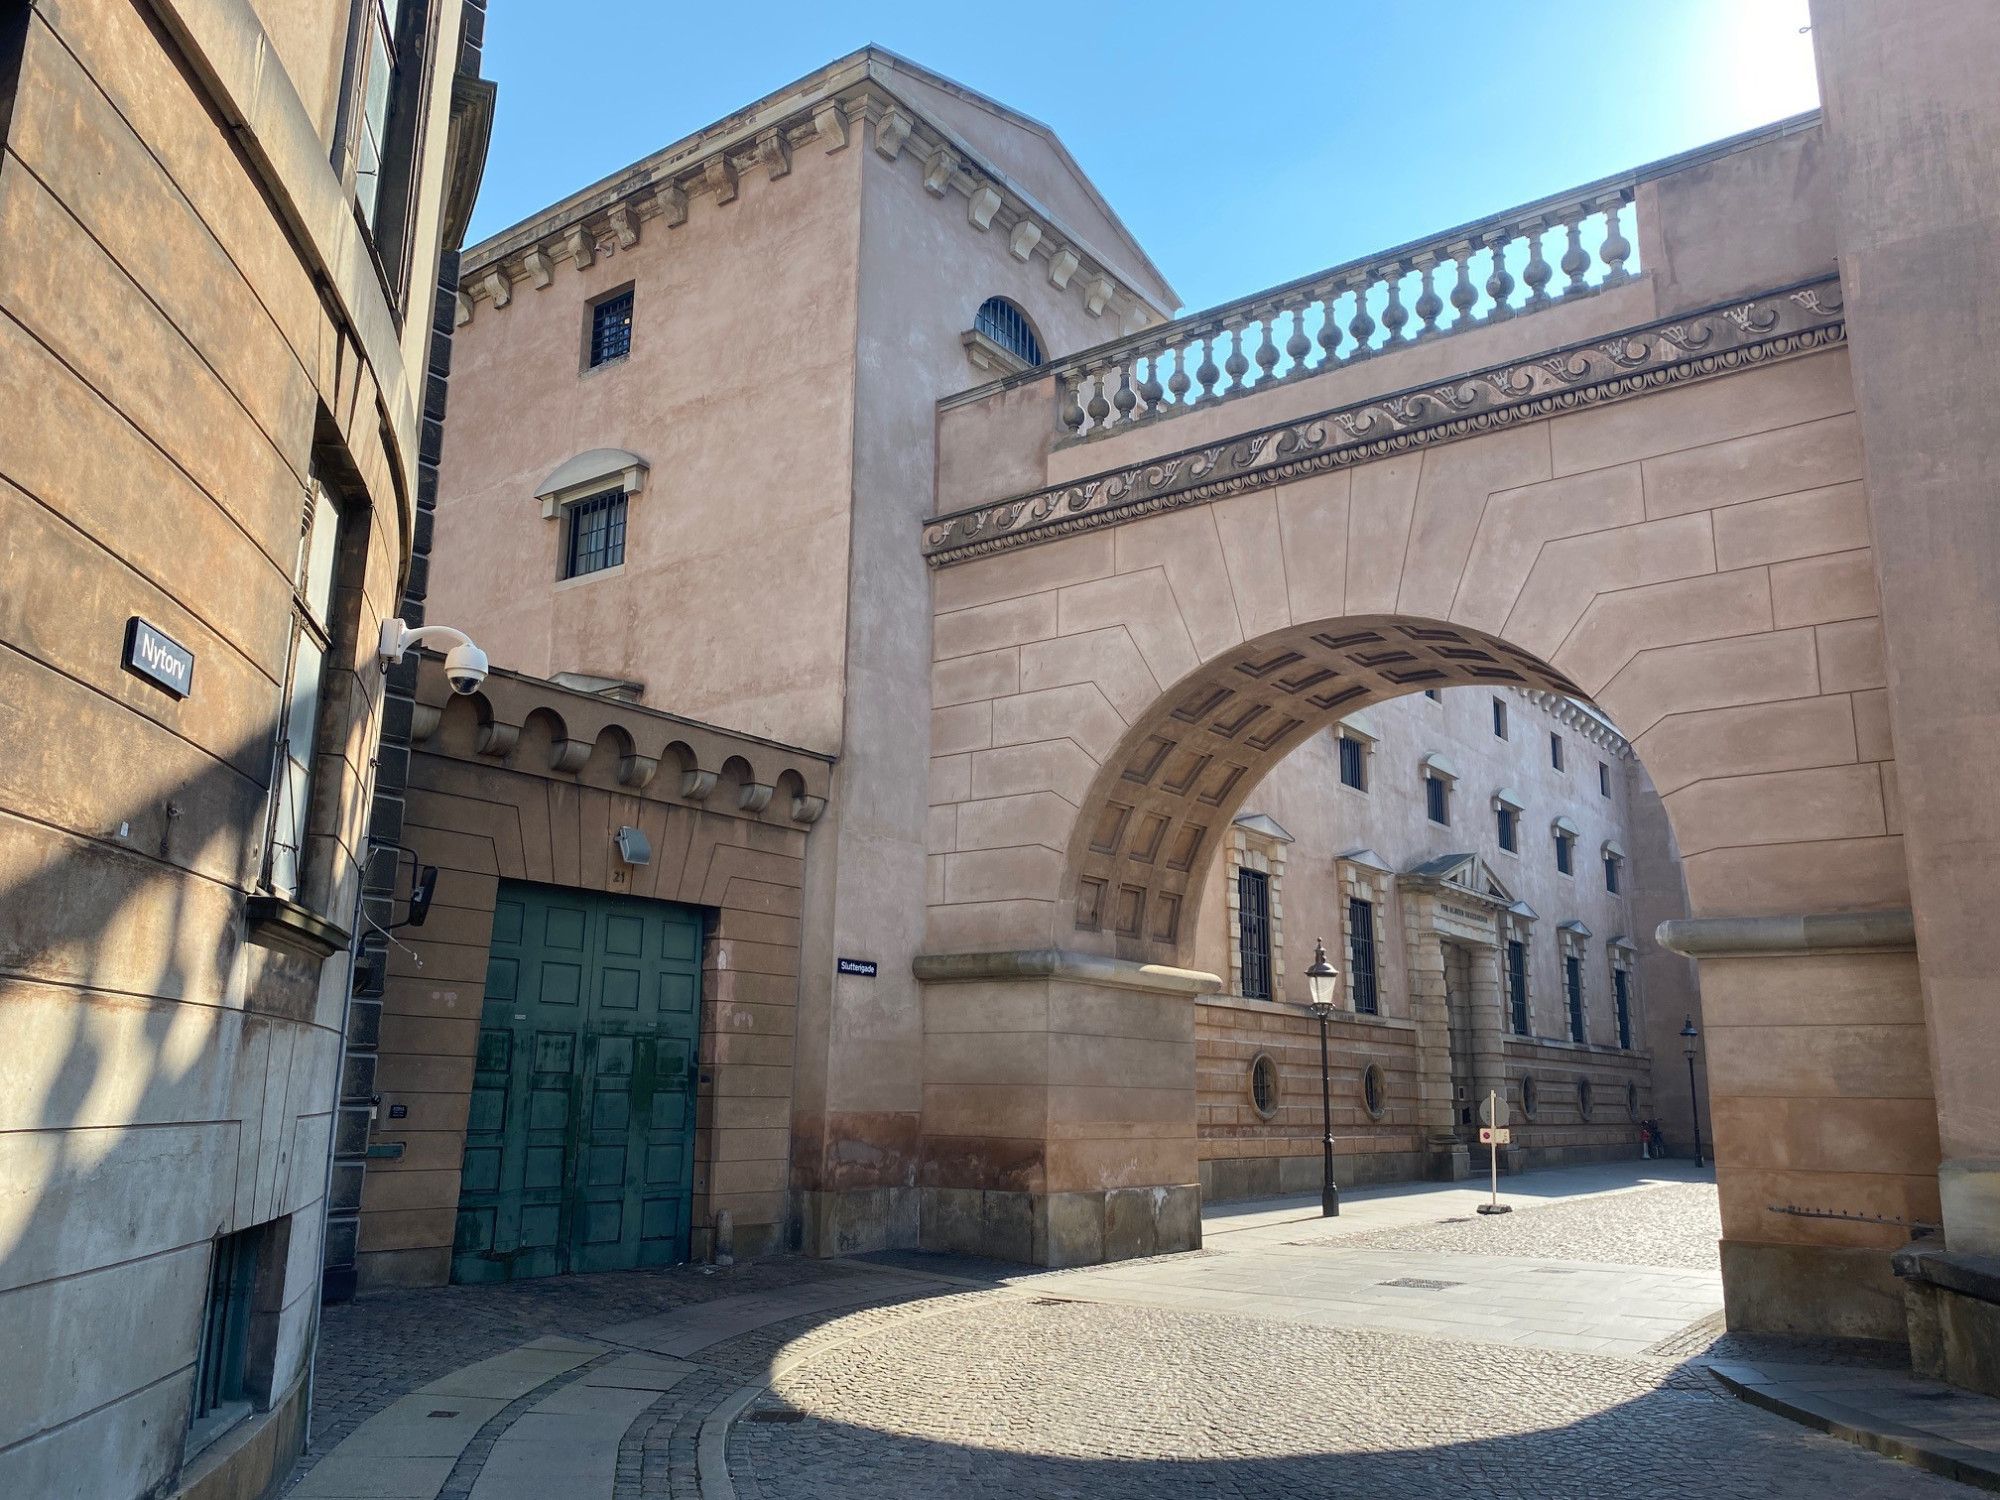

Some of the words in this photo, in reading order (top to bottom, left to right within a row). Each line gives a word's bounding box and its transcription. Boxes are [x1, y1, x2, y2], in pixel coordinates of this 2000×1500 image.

[142, 632, 186, 680] Nytorv
[613, 871, 625, 883] 21
[840, 961, 875, 974] Slutterigade
